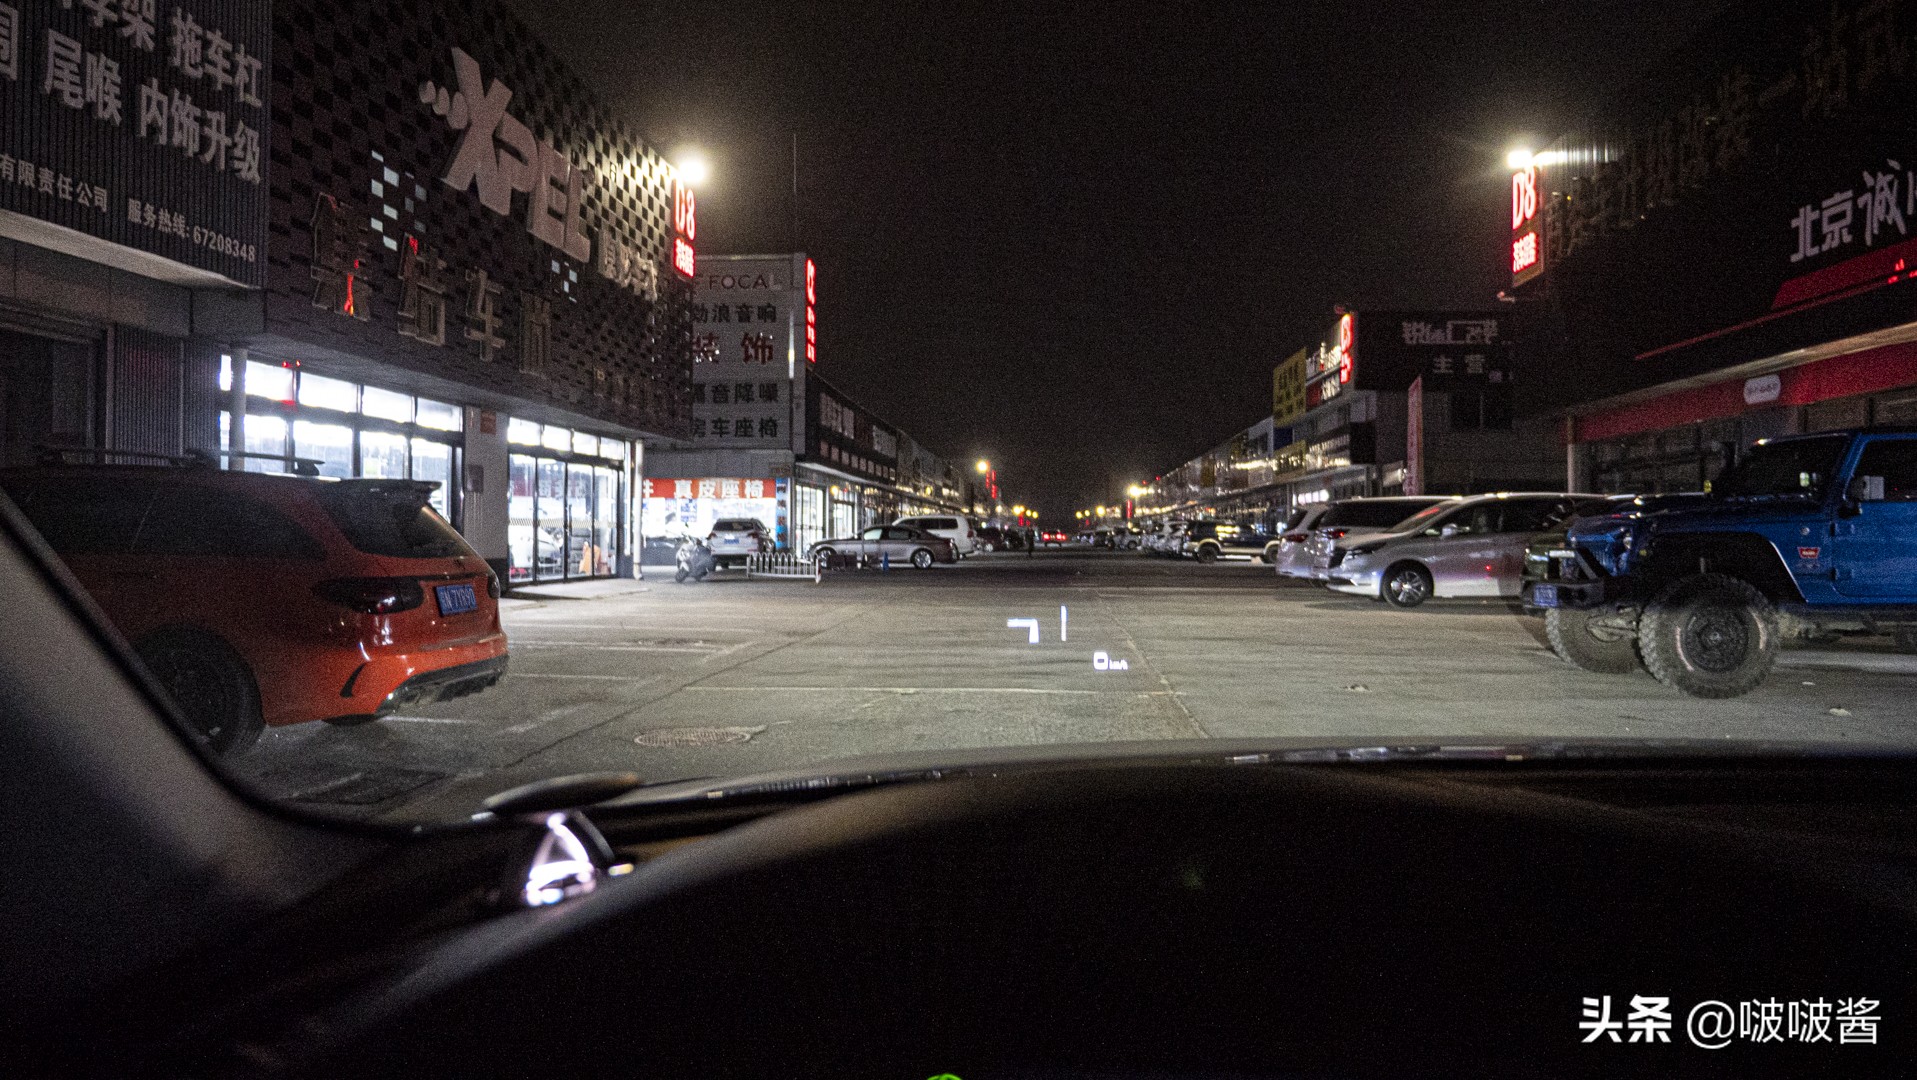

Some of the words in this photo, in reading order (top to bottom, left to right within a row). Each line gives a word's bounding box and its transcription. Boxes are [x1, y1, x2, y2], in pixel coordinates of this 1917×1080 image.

[44, 27, 123, 127] 尾喉
[170, 6, 262, 107] 拖车杠
[139, 76, 261, 185] 内饰升级
[440, 47, 590, 262] XPEL
[0, 152, 108, 214] 有限责任公司
[675, 174, 696, 241] D8
[1512, 164, 1536, 230] D8
[1791, 158, 1917, 263] 北京诚
[709, 273, 783, 291] FOCAL
[673, 479, 765, 499] 真皮座椅
